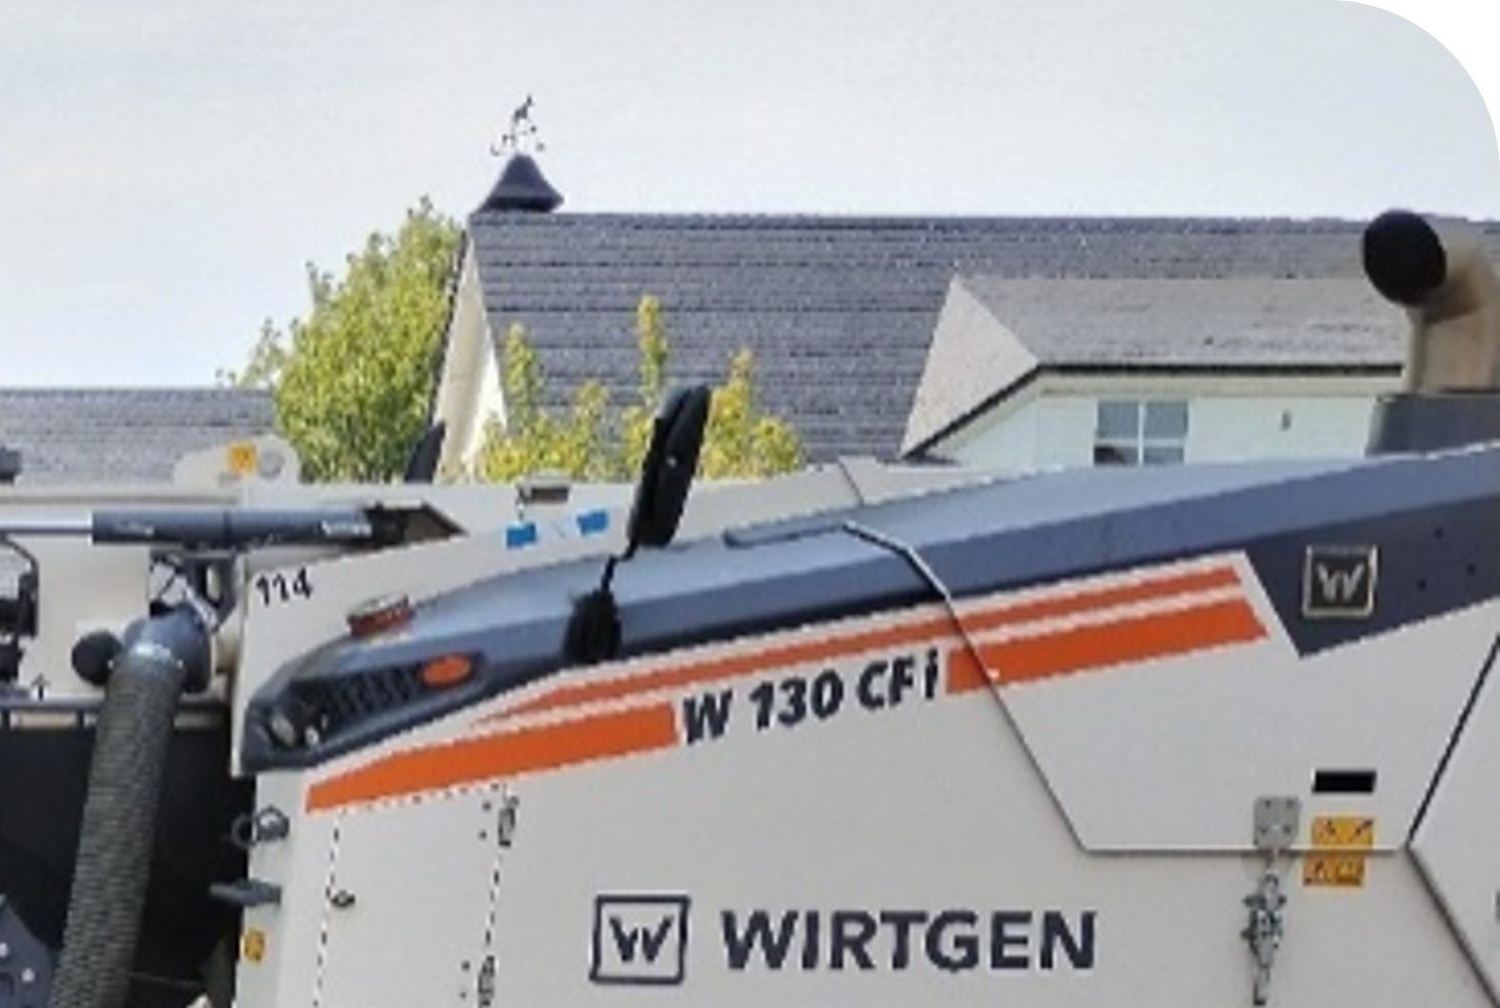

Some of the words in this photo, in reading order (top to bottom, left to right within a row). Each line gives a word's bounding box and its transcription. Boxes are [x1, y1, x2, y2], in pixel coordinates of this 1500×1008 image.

[683, 689, 733, 745] W
[750, 669, 844, 731] 130
[721, 910, 1097, 972] WIRTGEN
